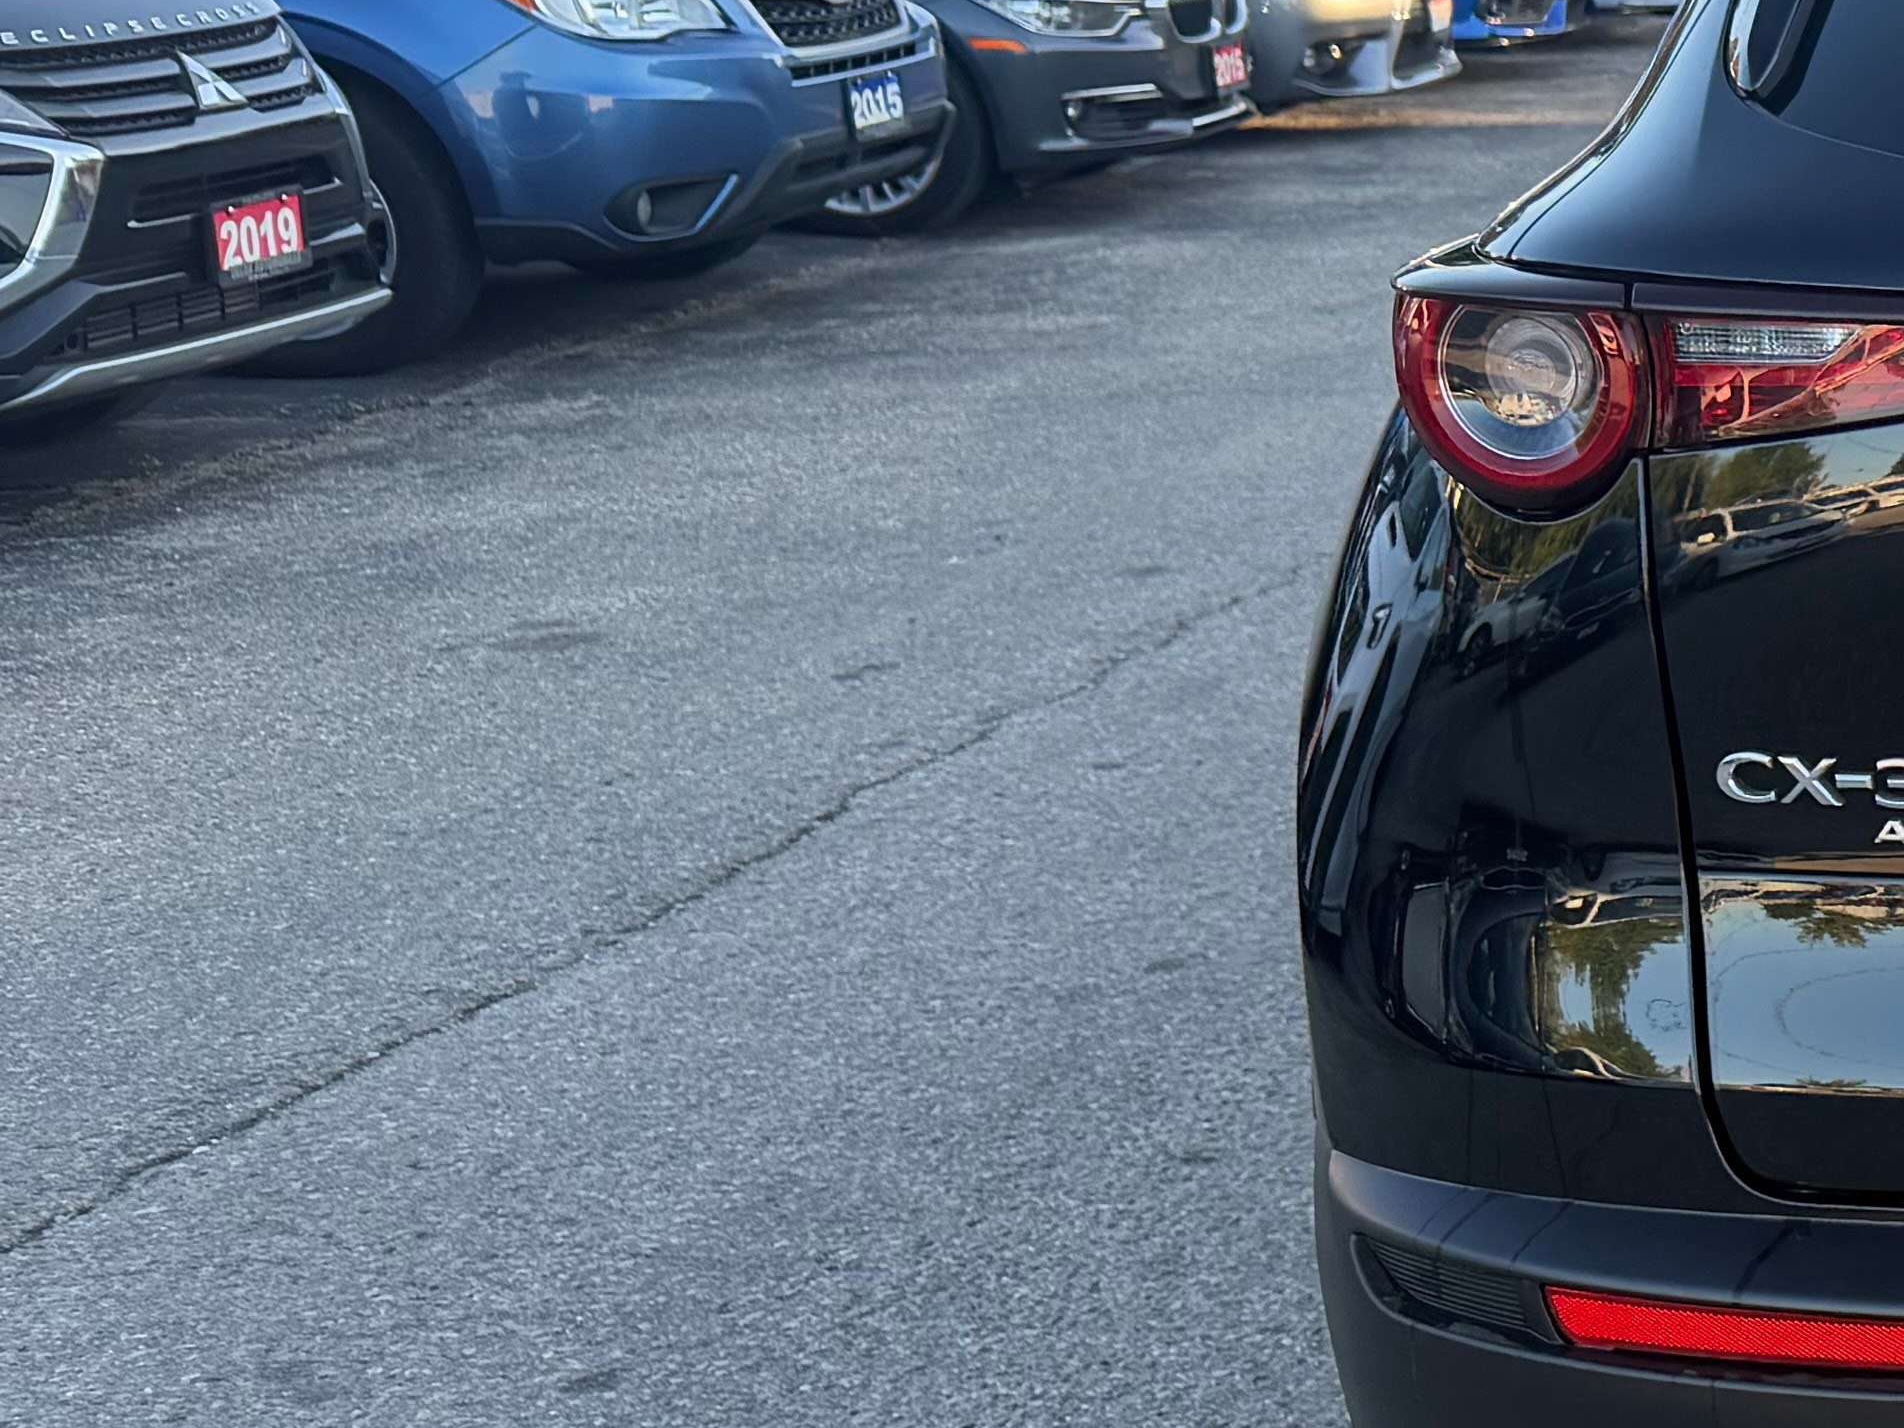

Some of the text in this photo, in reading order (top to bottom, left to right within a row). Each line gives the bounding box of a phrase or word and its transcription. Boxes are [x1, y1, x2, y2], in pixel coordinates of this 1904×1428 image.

[1214, 48, 1246, 86] 2015
[851, 80, 904, 129] 2015
[220, 207, 298, 271] 2019
